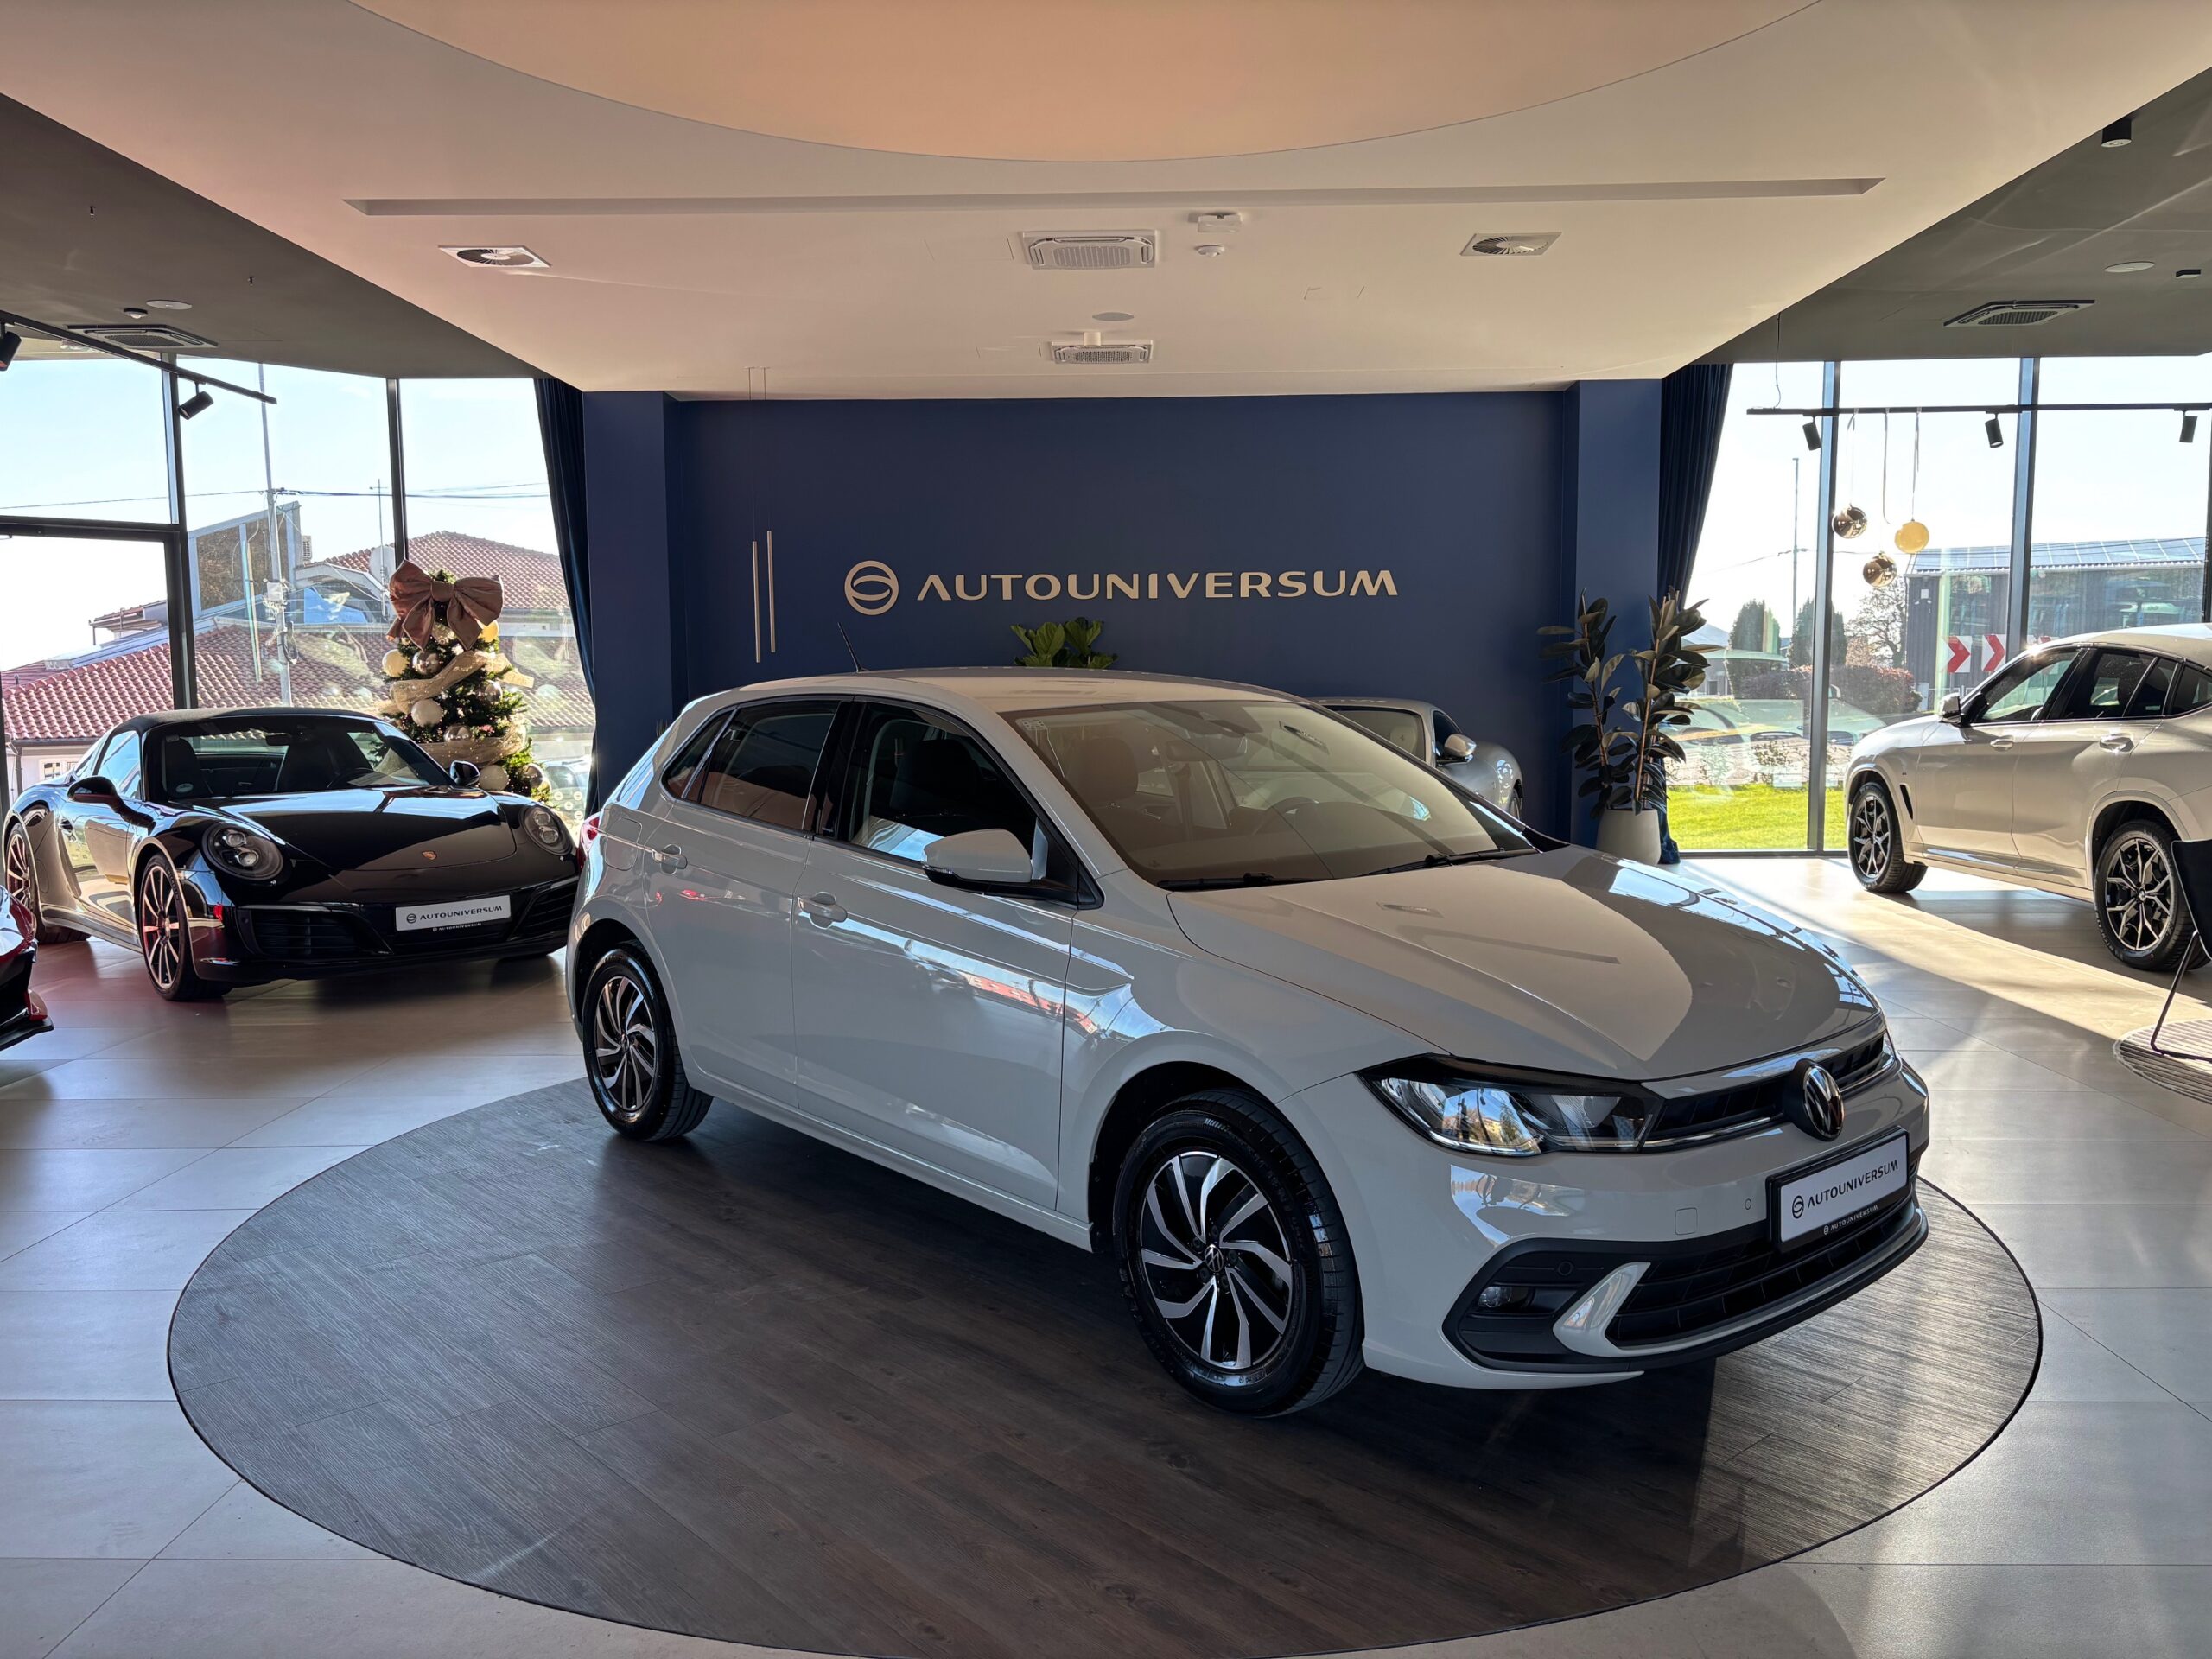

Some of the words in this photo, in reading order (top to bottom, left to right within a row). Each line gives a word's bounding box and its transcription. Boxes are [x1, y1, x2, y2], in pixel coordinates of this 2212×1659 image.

[917, 570, 1398, 601] AUTOUNIVERSUM
[420, 906, 502, 920] AUTOUNIVERSUM
[1807, 1160, 1898, 1209] AUTOUNIVERSUM
[1830, 1205, 1878, 1231] AUTOUNIVERSUM
